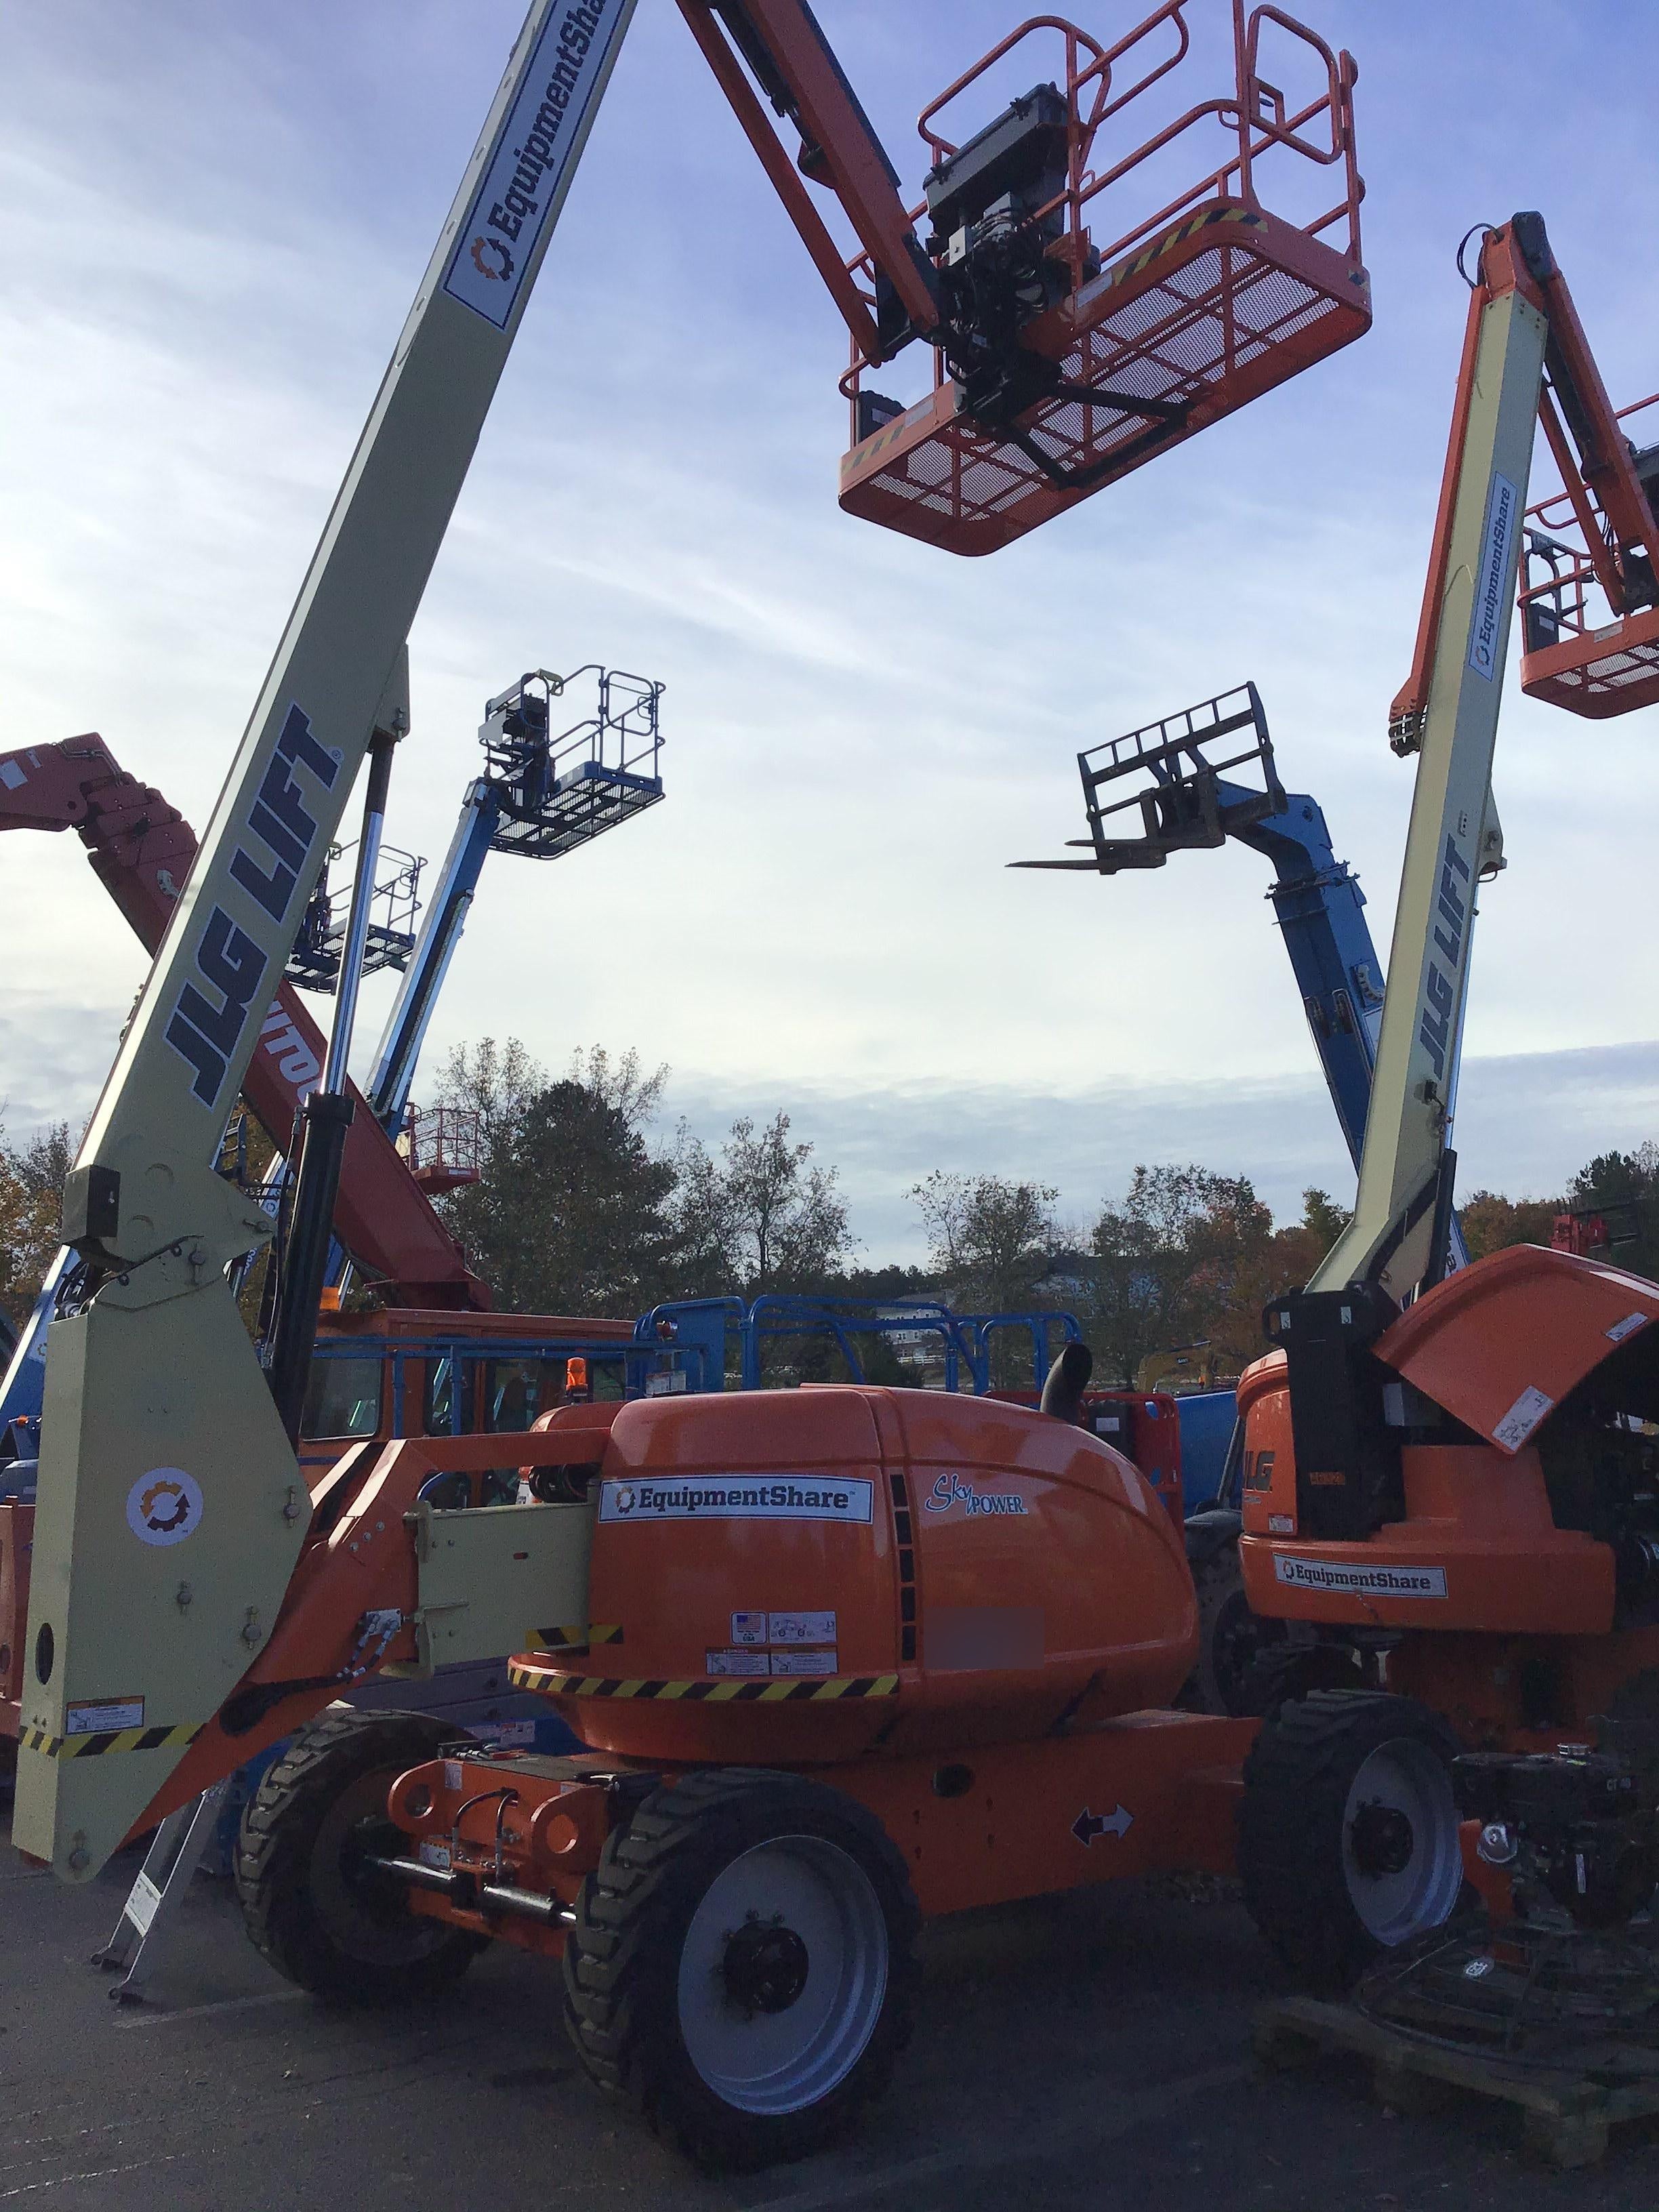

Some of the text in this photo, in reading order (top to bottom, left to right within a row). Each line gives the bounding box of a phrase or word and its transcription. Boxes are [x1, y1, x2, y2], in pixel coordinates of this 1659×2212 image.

[1478, 487, 1511, 646] EquipmentShare
[163, 699, 340, 1113] JLG LIFT
[1420, 833, 1470, 1082] JLG LIFT
[638, 1486, 849, 1513] EquipmentShare
[1295, 1564, 1431, 1590] EquipmentShare
